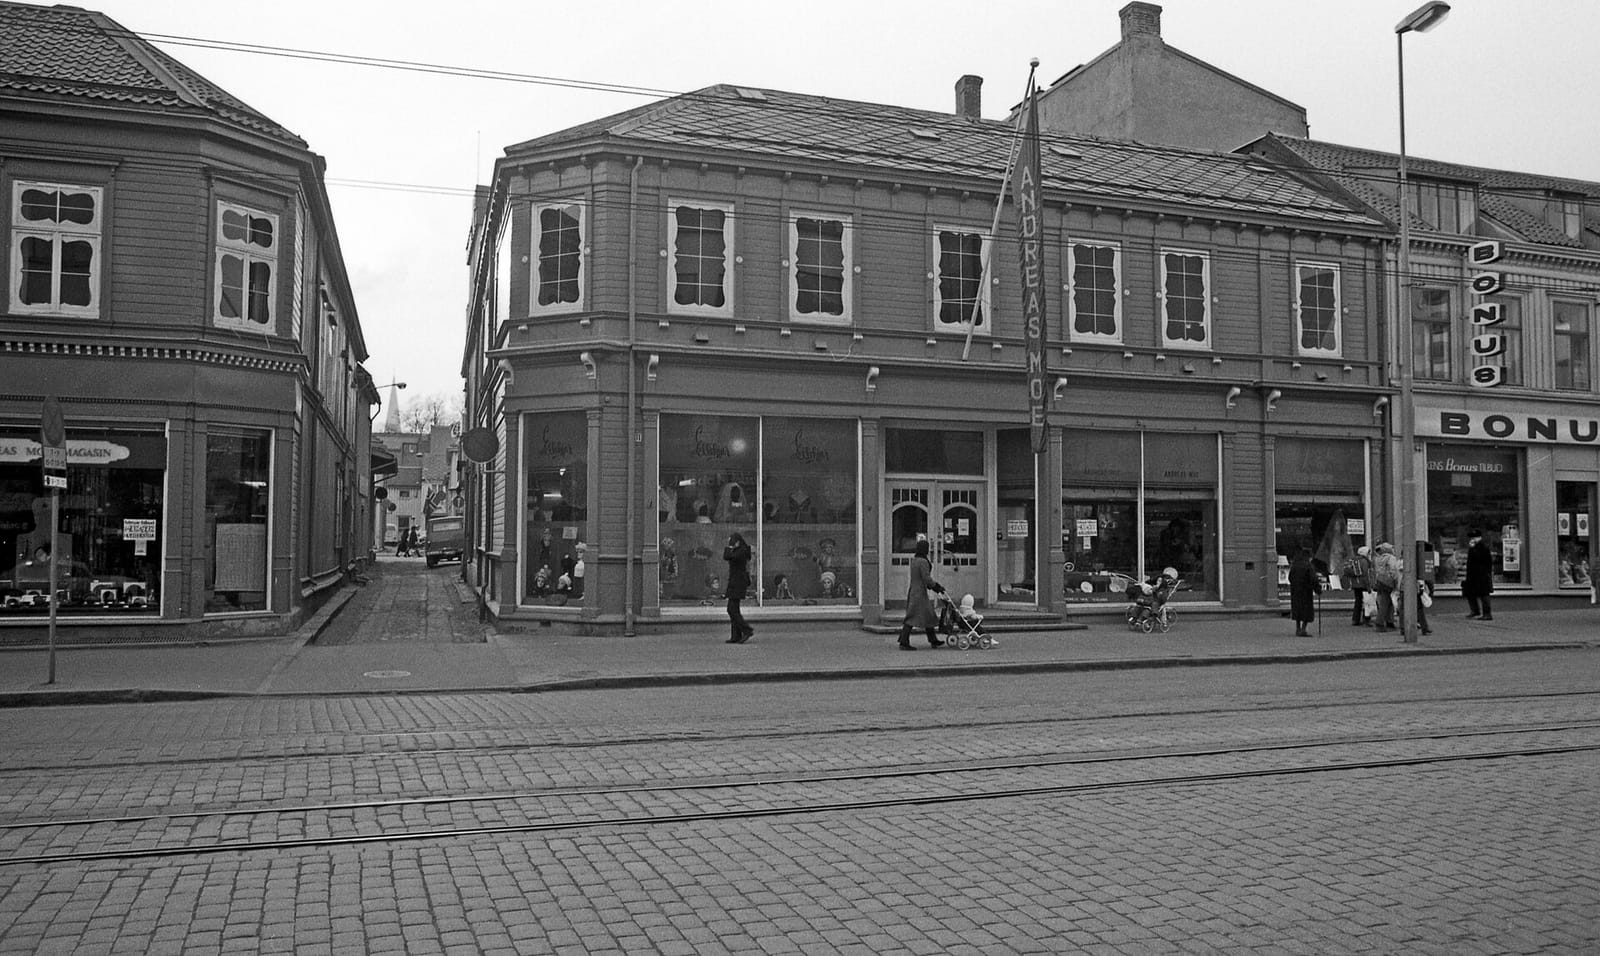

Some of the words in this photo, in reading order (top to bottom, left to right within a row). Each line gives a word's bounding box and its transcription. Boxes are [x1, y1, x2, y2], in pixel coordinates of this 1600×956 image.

[1020, 166, 1040, 338] ANDREAS
[1030, 351, 1044, 427] MOE
[1473, 244, 1496, 383] BONUS
[1440, 411, 1598, 442] BONU
[0, 446, 17, 456] AS
[1445, 458, 1478, 472] Bonus
[1479, 462, 1504, 473] TILBUD
